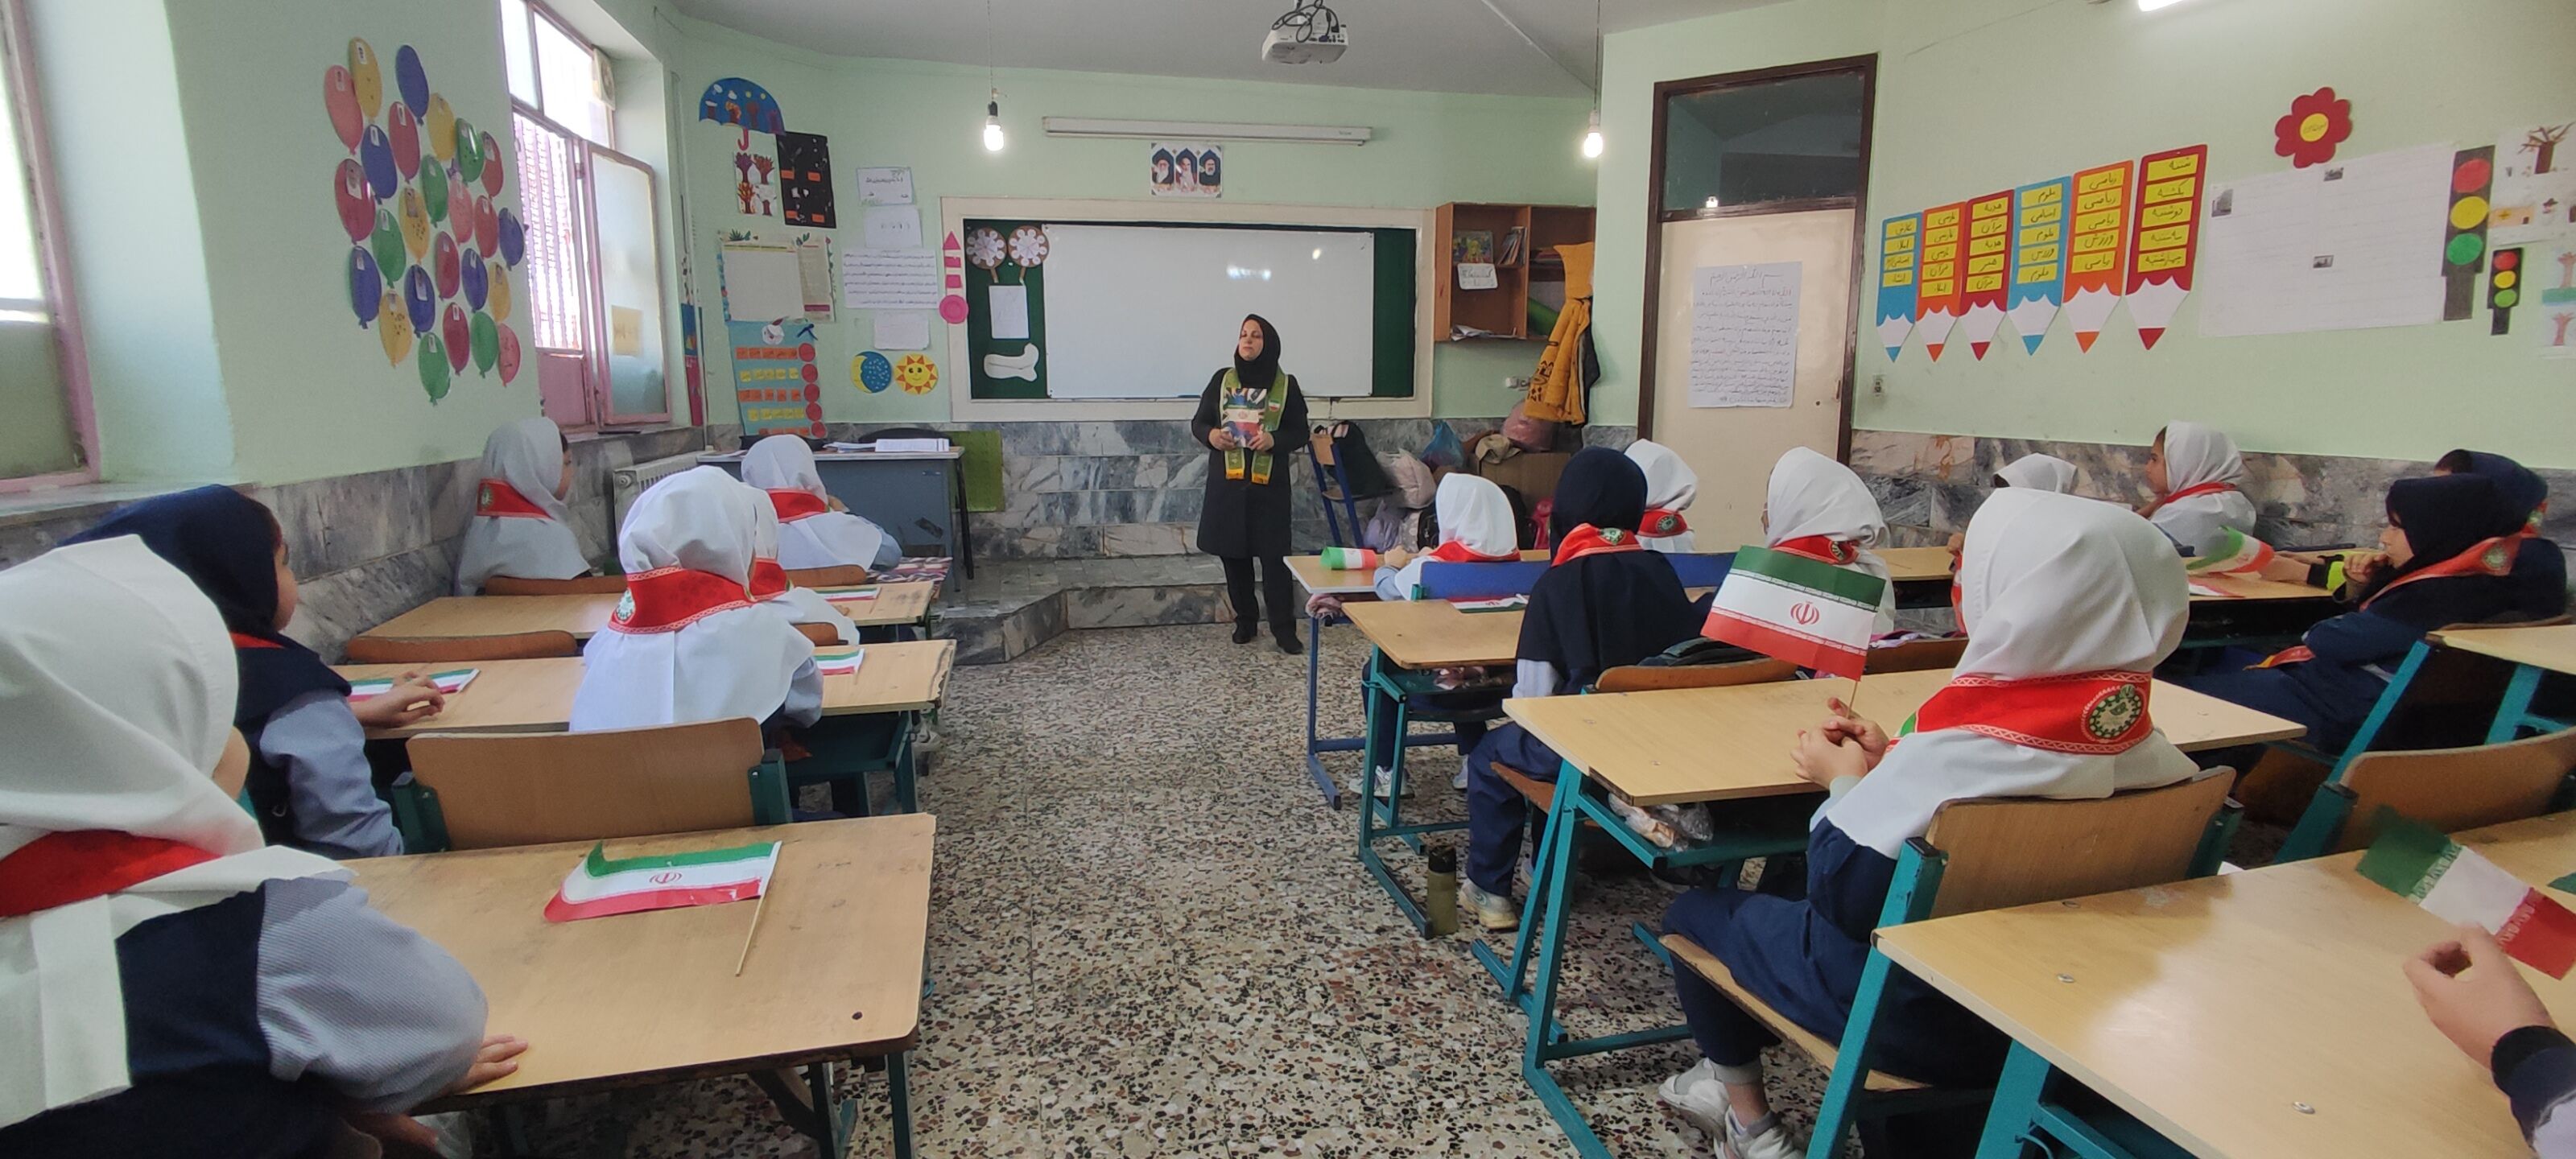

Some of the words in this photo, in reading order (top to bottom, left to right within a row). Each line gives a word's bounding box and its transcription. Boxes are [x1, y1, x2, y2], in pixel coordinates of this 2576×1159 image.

[2169, 157, 2191, 171] شنبه
[2089, 172, 2117, 190] ریاضی
[2157, 178, 2190, 198] یکشنبه
[2037, 187, 2055, 203] علوم
[2084, 192, 2116, 210] ریاضی
[2152, 205, 2183, 220] دوشنبه
[1981, 218, 2003, 233] قرآن
[2087, 213, 2114, 230] ریاضی
[2036, 228, 2054, 241] علوم
[2084, 233, 2114, 249] ورزش
[2084, 254, 2111, 270] ریاضی
[2145, 252, 2182, 266] چهارشنبه
[2030, 266, 2049, 282] علوم
[1975, 276, 1993, 289] قرآن
